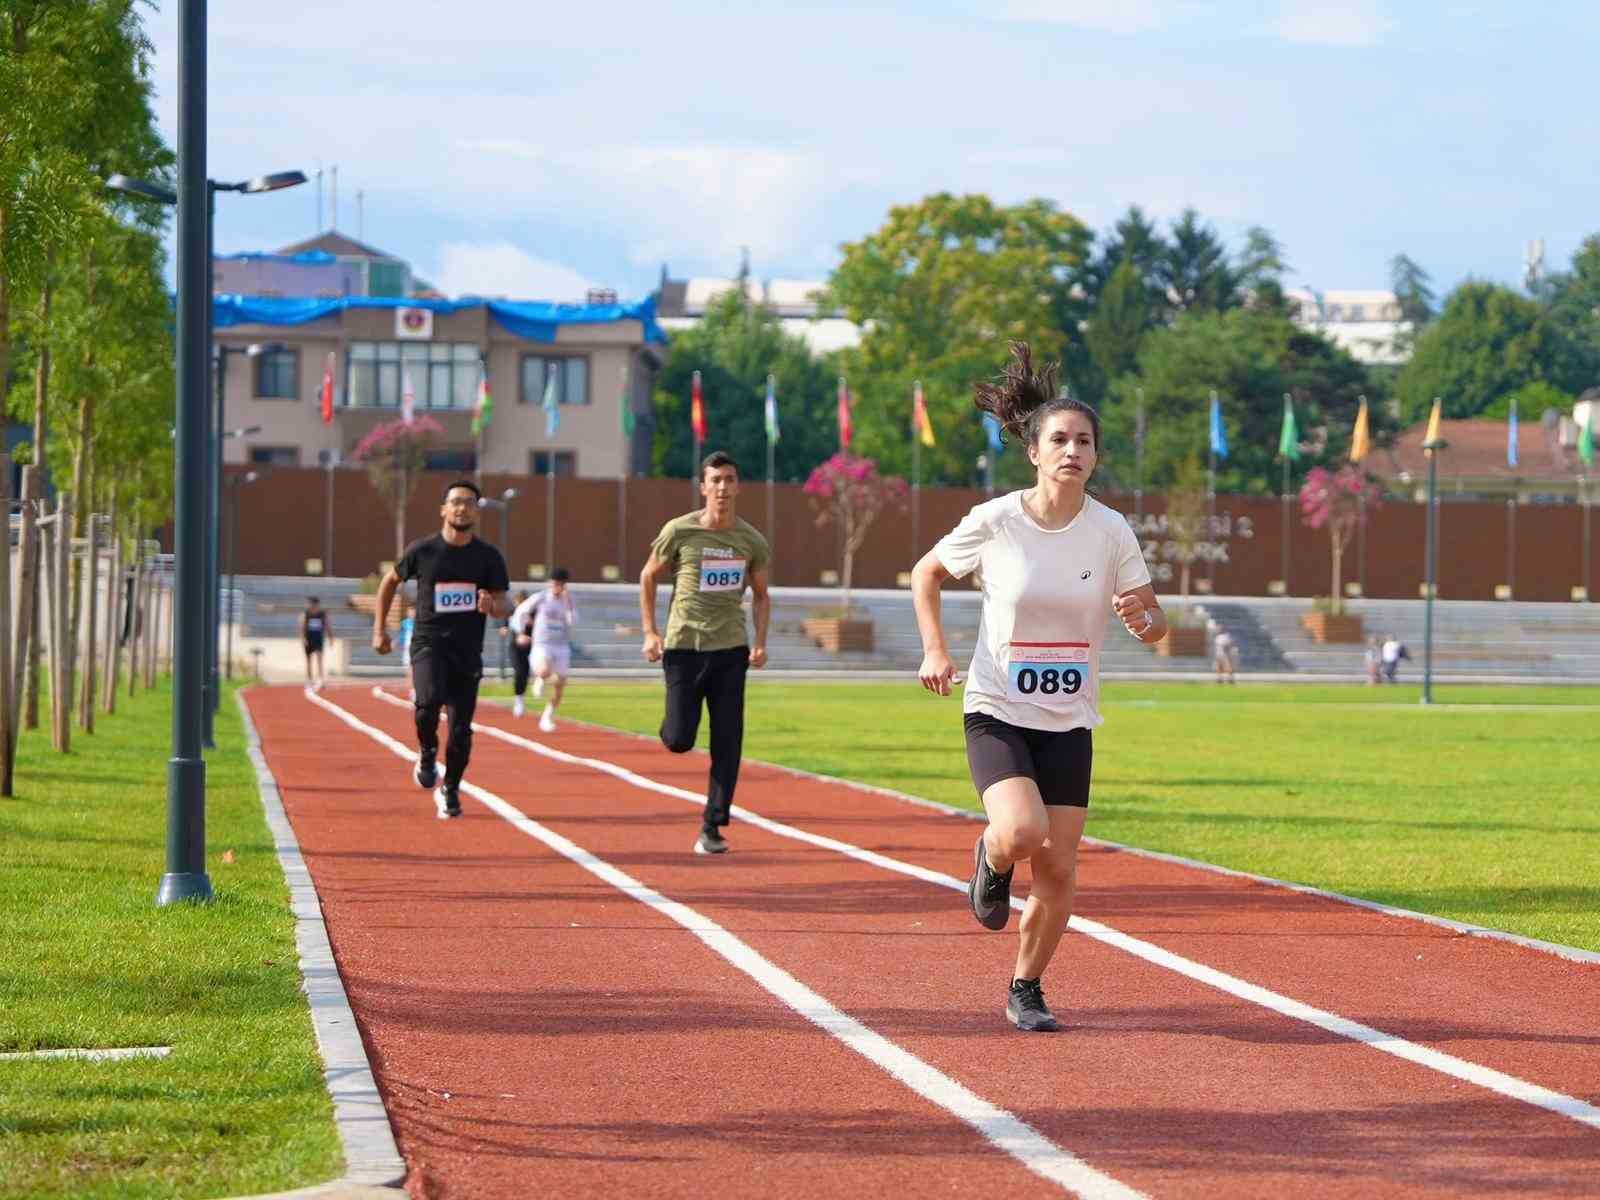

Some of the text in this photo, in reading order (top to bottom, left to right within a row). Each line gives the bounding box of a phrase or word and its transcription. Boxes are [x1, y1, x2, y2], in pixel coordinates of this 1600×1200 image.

[707, 572, 741, 586] 083
[441, 592, 473, 607] 020
[1017, 668, 1082, 695] 089
